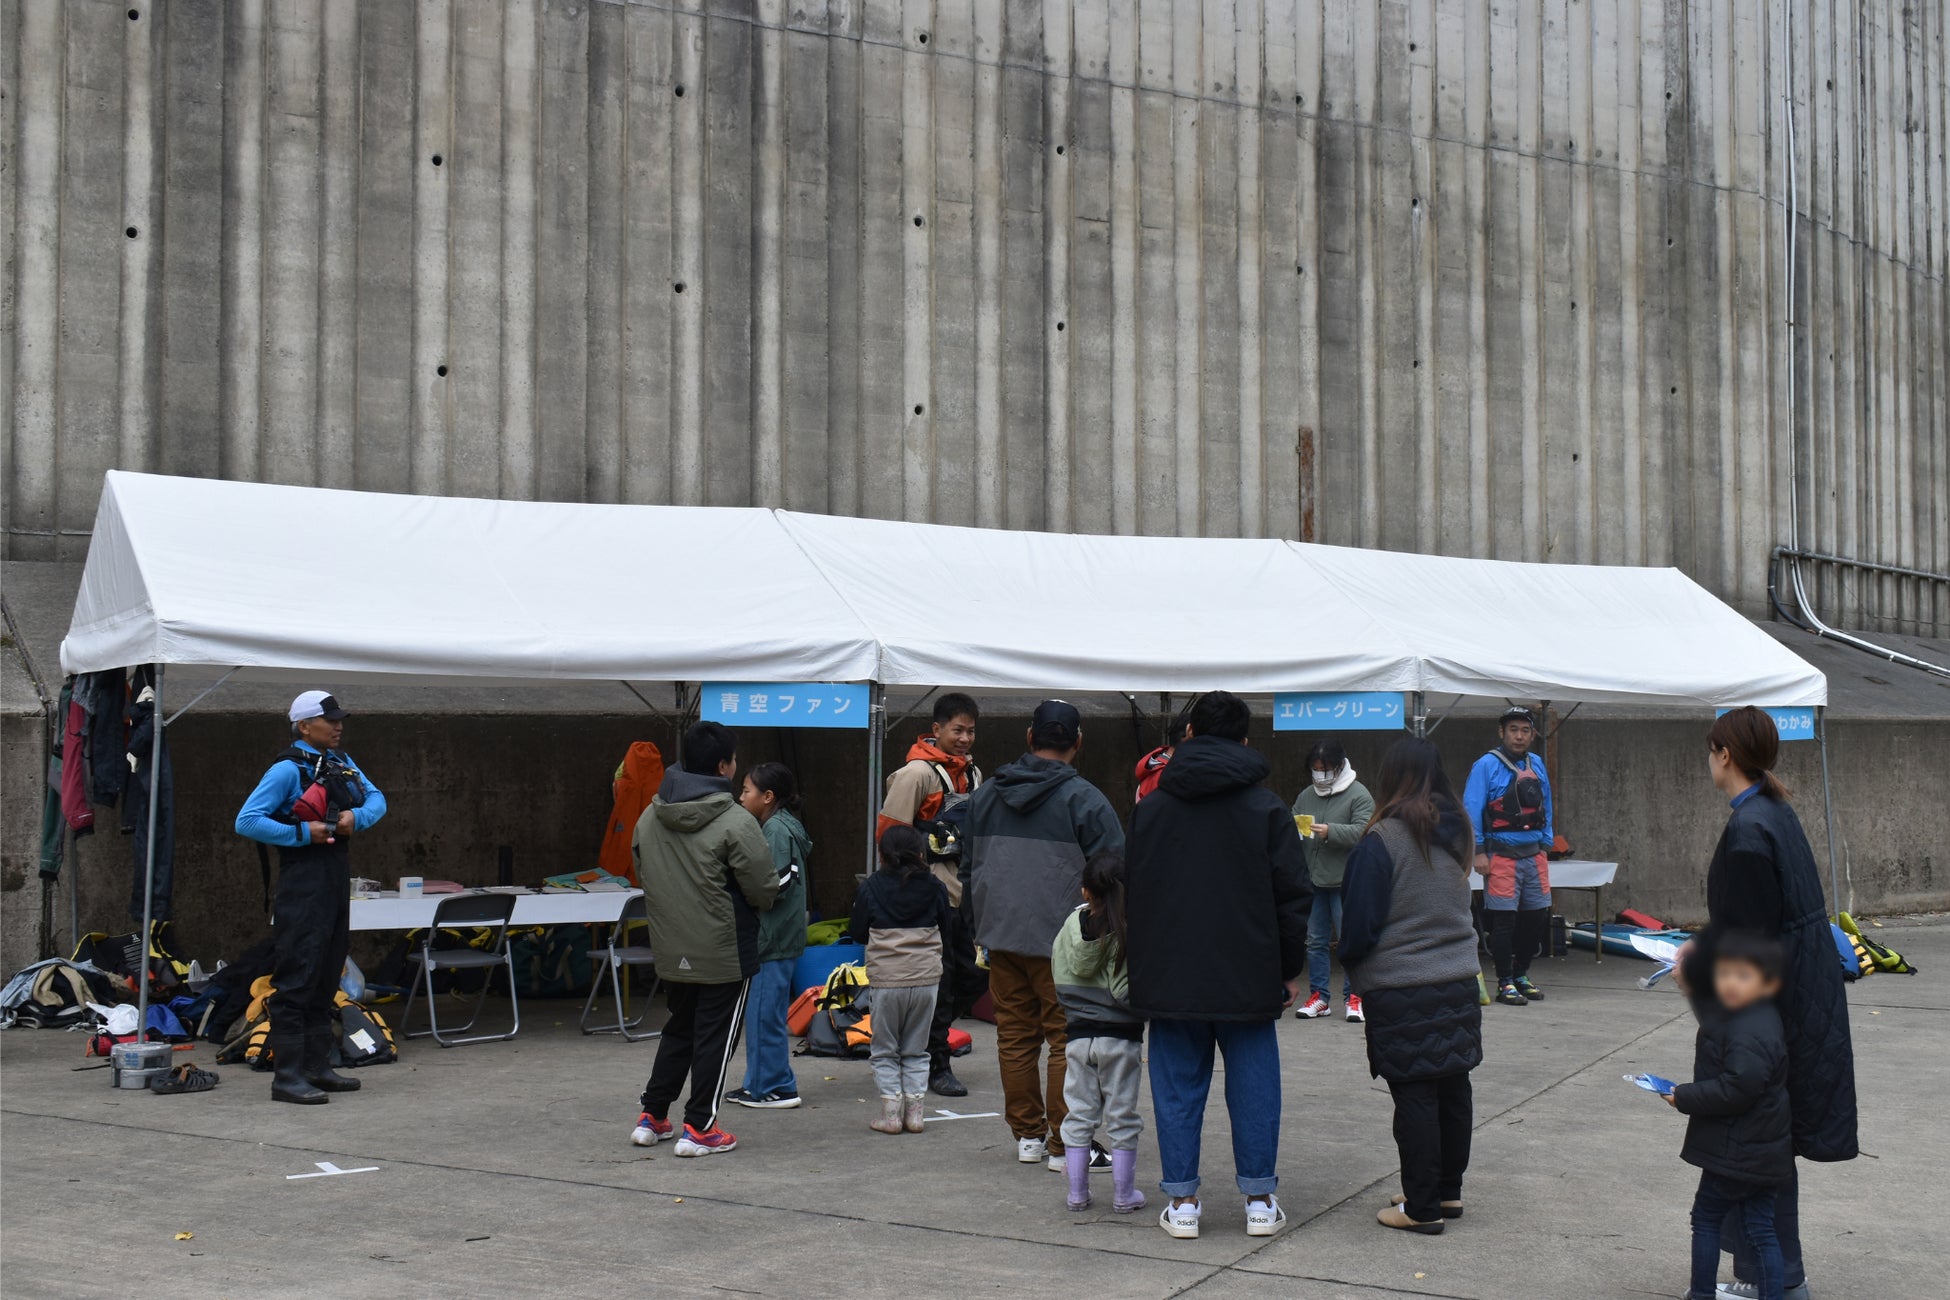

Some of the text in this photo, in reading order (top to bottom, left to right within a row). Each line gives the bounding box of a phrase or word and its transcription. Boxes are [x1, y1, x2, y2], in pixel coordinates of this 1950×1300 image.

[720, 693, 850, 713] 青空ファン
[1280, 701, 1399, 718] エバーグリーン
